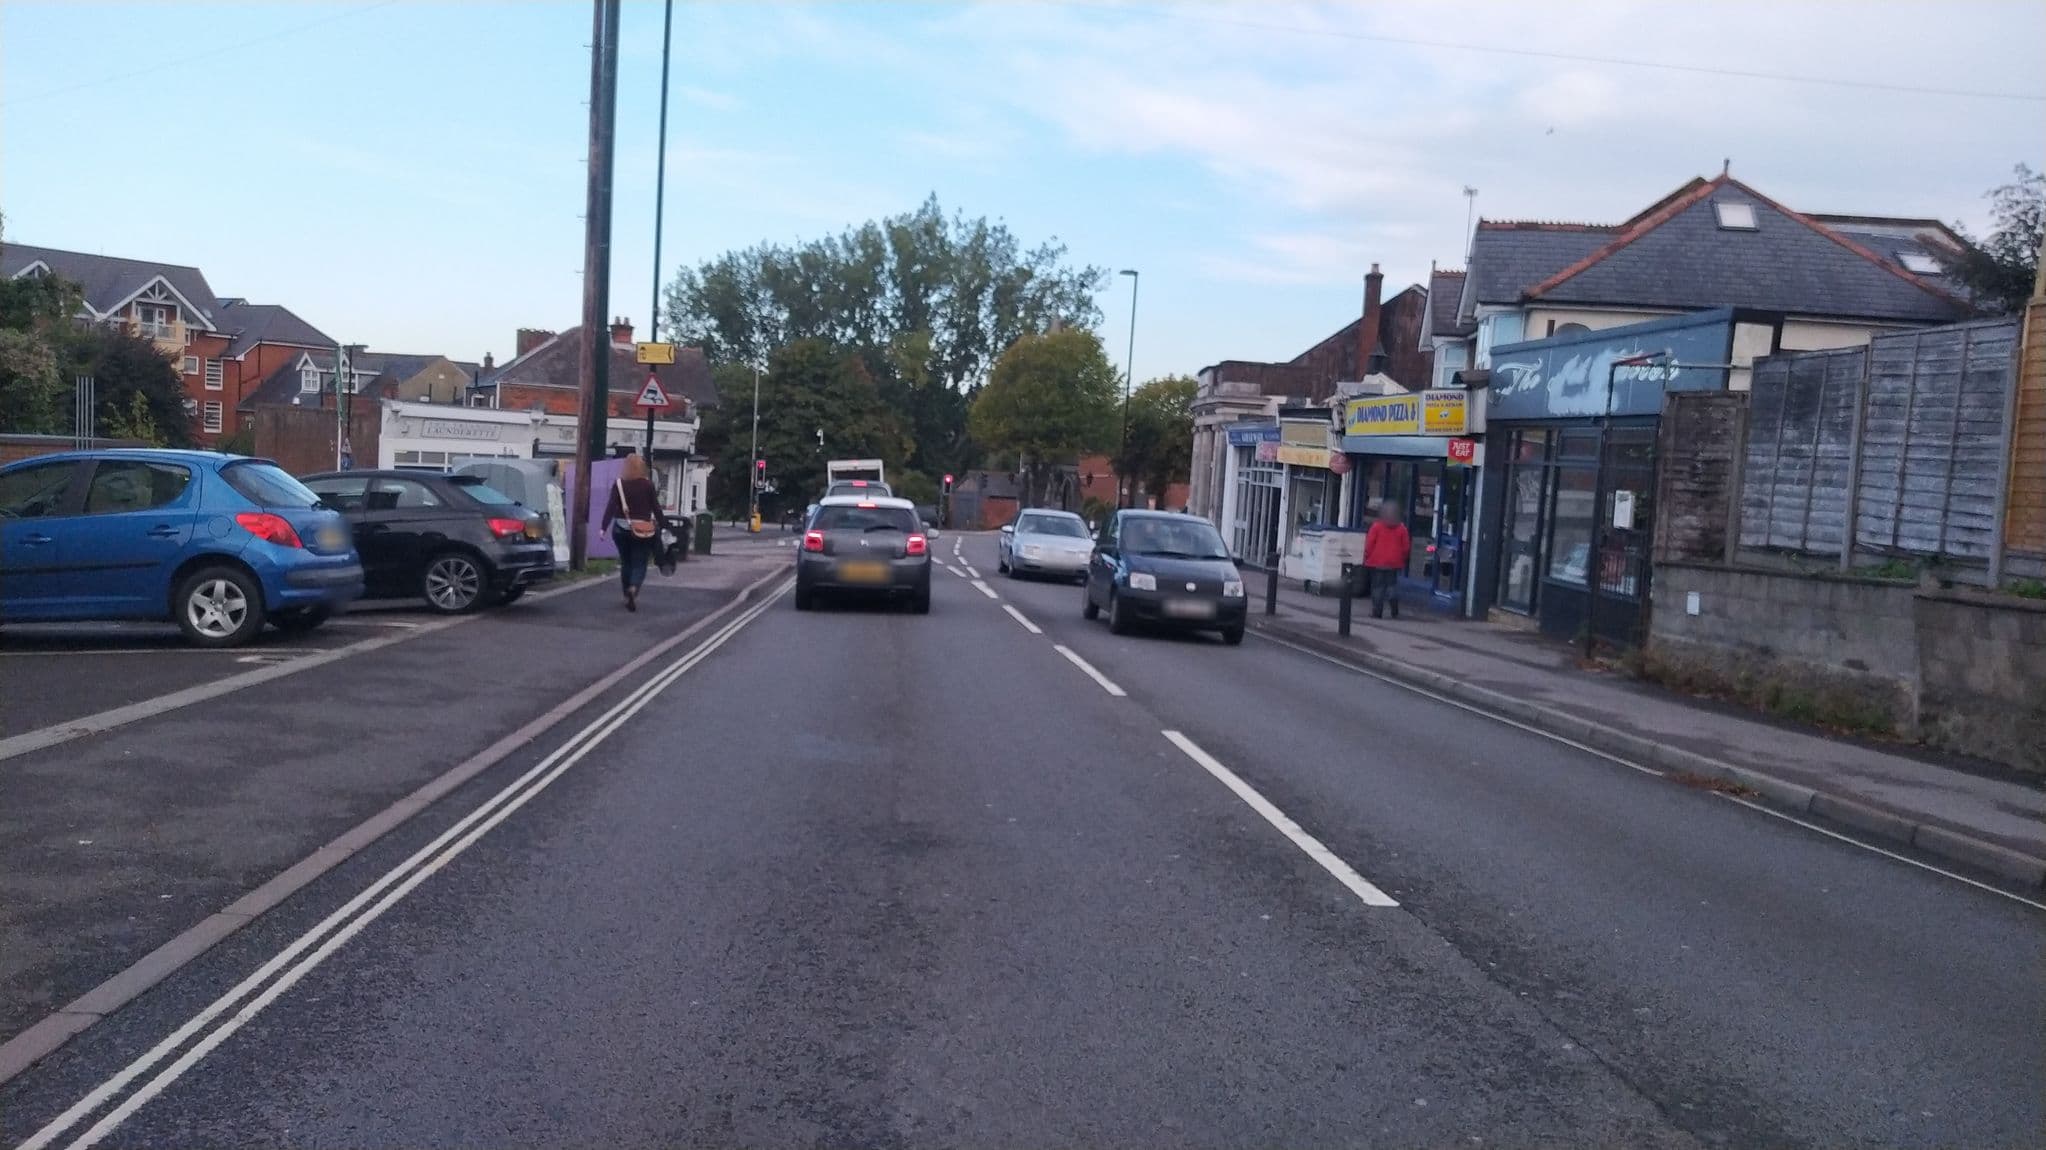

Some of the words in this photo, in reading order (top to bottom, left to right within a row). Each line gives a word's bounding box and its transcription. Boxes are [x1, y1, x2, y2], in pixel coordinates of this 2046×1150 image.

[1425, 393, 1464, 401] DIAMOND
[1357, 406, 1387, 423] DIAMOND
[1388, 403, 1408, 422] PIZZA
[427, 427, 496, 437] LAUNDERETTE
[1452, 442, 1471, 450] JUST
